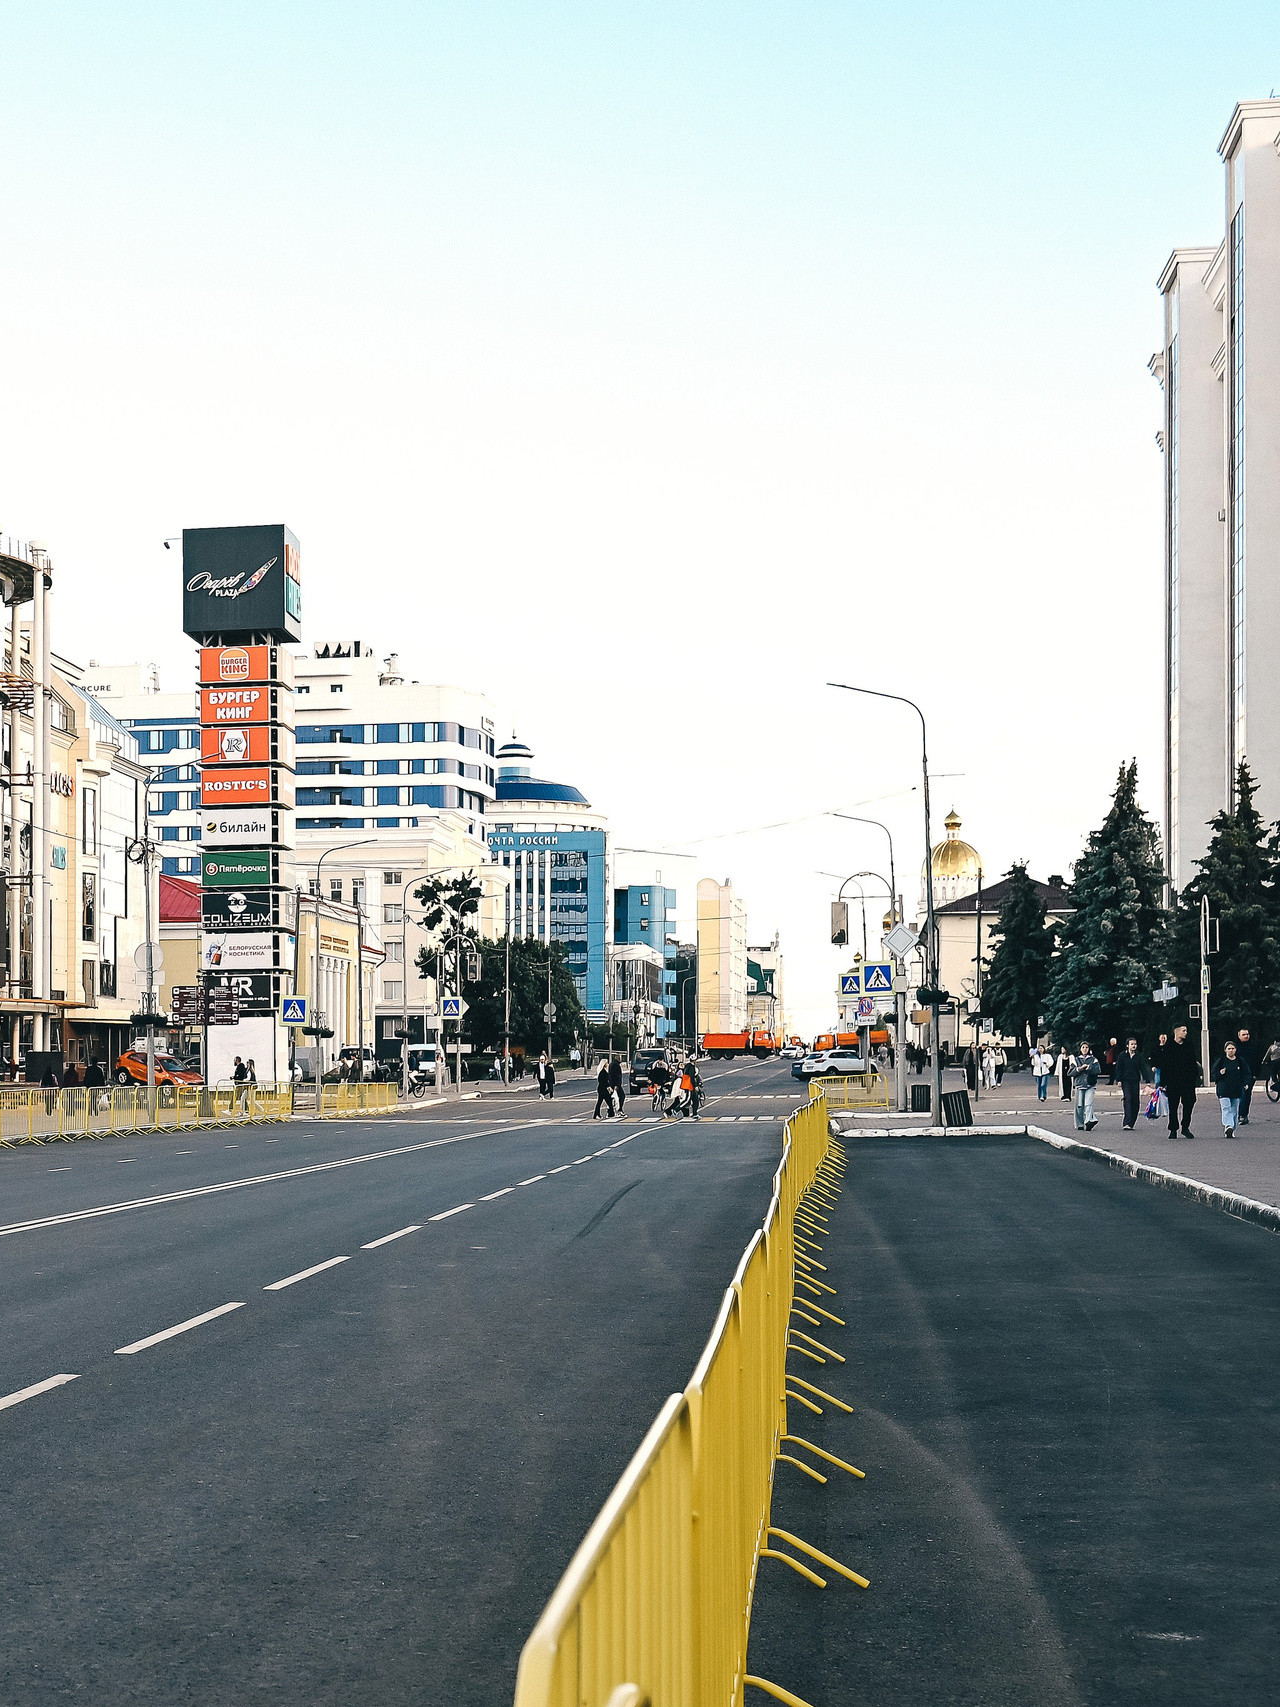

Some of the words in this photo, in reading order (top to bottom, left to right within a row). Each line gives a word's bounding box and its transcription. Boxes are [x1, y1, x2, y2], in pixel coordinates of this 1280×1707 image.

[215, 588, 239, 598] PLAZA
[221, 664, 248, 674] KING
[209, 690, 260, 704] БУРГЕР
[216, 705, 254, 720] КИНГ
[204, 780, 268, 791] ROSTIC'S
[219, 821, 266, 833] билайн
[488, 836, 515, 846] ОЧТА
[519, 836, 558, 845] РОССИИ
[219, 864, 267, 874] Пятёрочка
[202, 913, 271, 923] COLIZEUM
